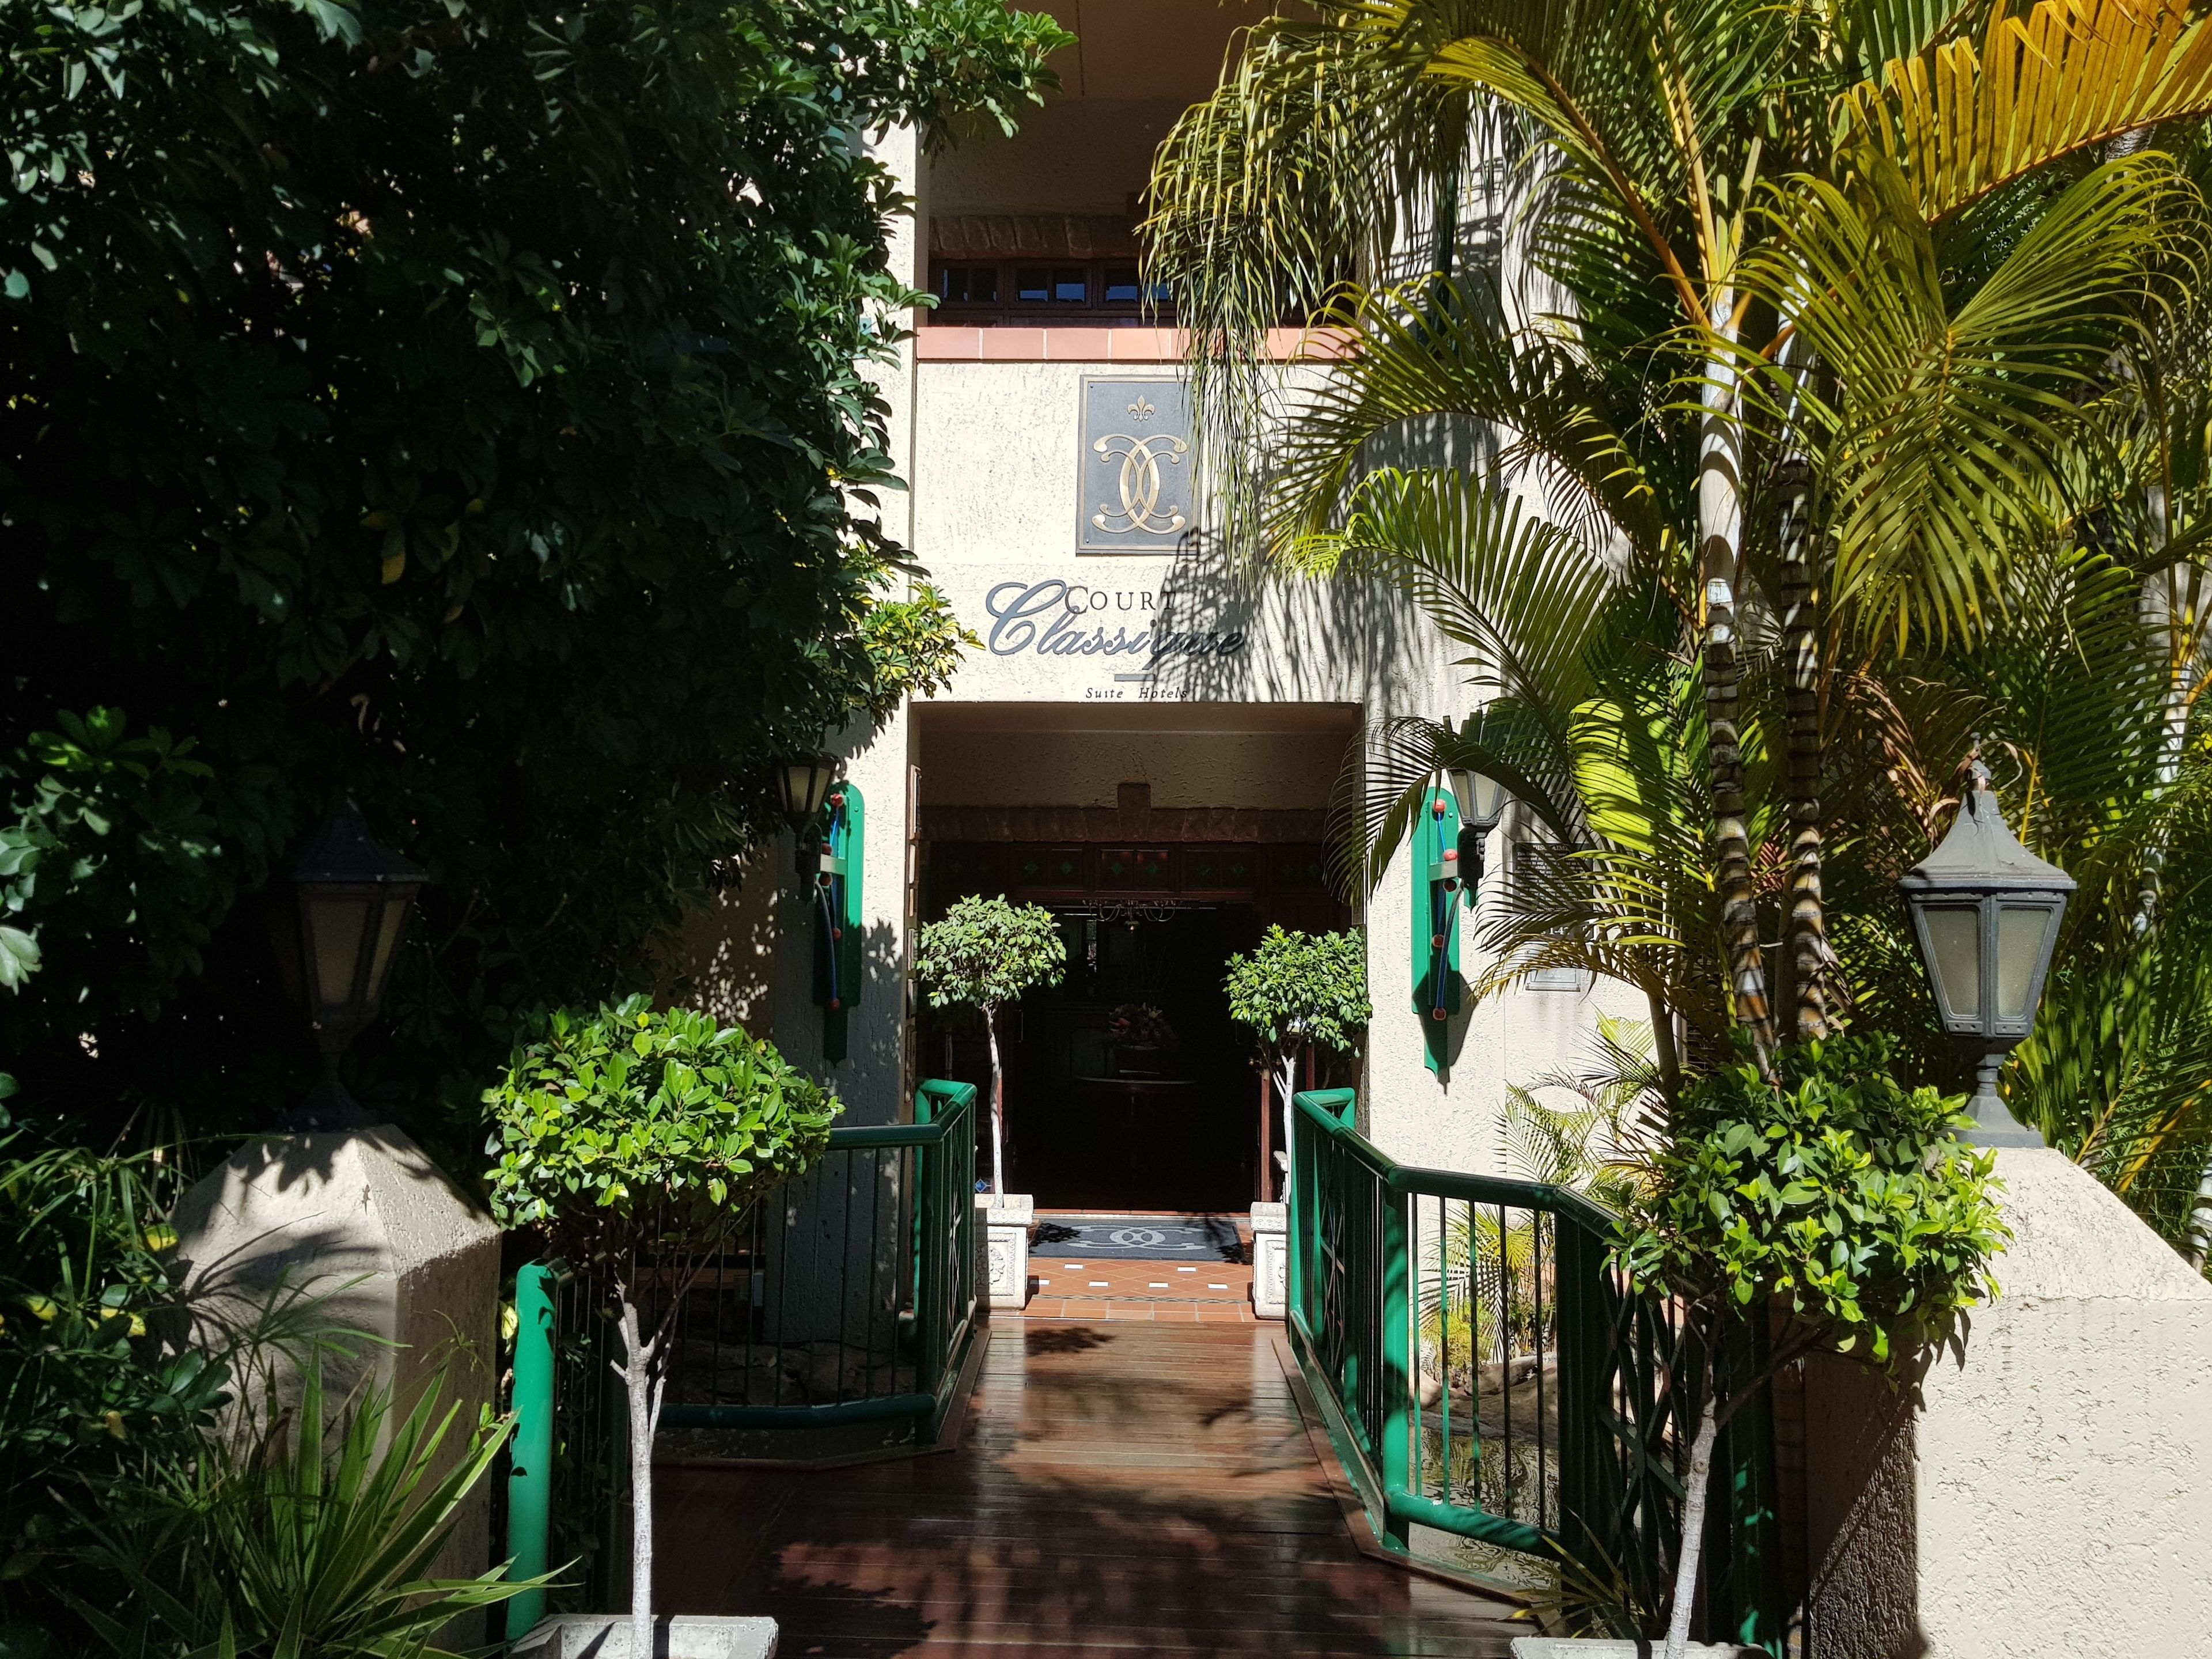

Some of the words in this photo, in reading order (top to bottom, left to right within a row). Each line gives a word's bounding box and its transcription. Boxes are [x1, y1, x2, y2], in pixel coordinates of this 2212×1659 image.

[1065, 585, 1176, 615] COURT
[986, 579, 1246, 671] Classique
[1085, 687, 1123, 699] Suite
[1138, 686, 1188, 699] Hotels
